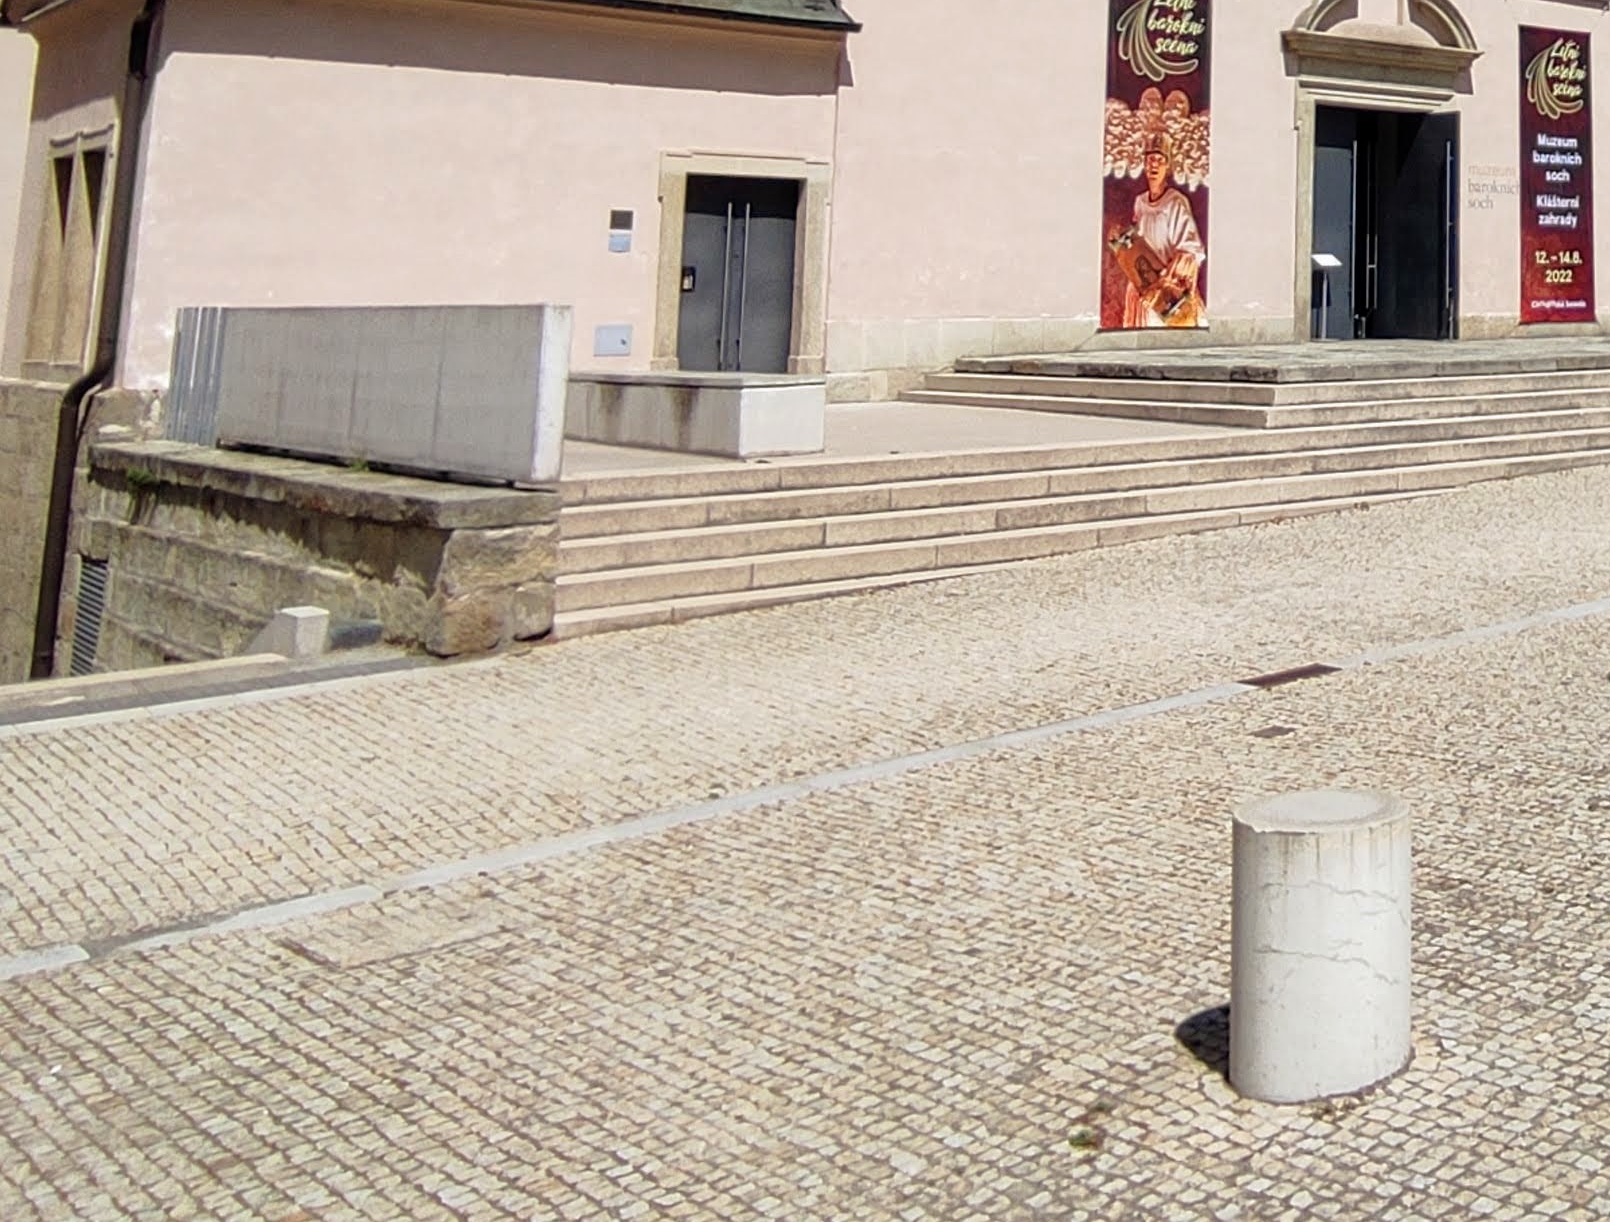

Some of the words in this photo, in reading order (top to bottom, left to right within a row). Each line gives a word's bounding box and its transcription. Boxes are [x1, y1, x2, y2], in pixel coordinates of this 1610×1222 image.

[1537, 134, 1578, 148] Muzeum
[1545, 169, 1570, 182] soch
[1467, 196, 1494, 209] soch
[1538, 213, 1578, 228] zahrady
[1545, 269, 1573, 283] 2022
